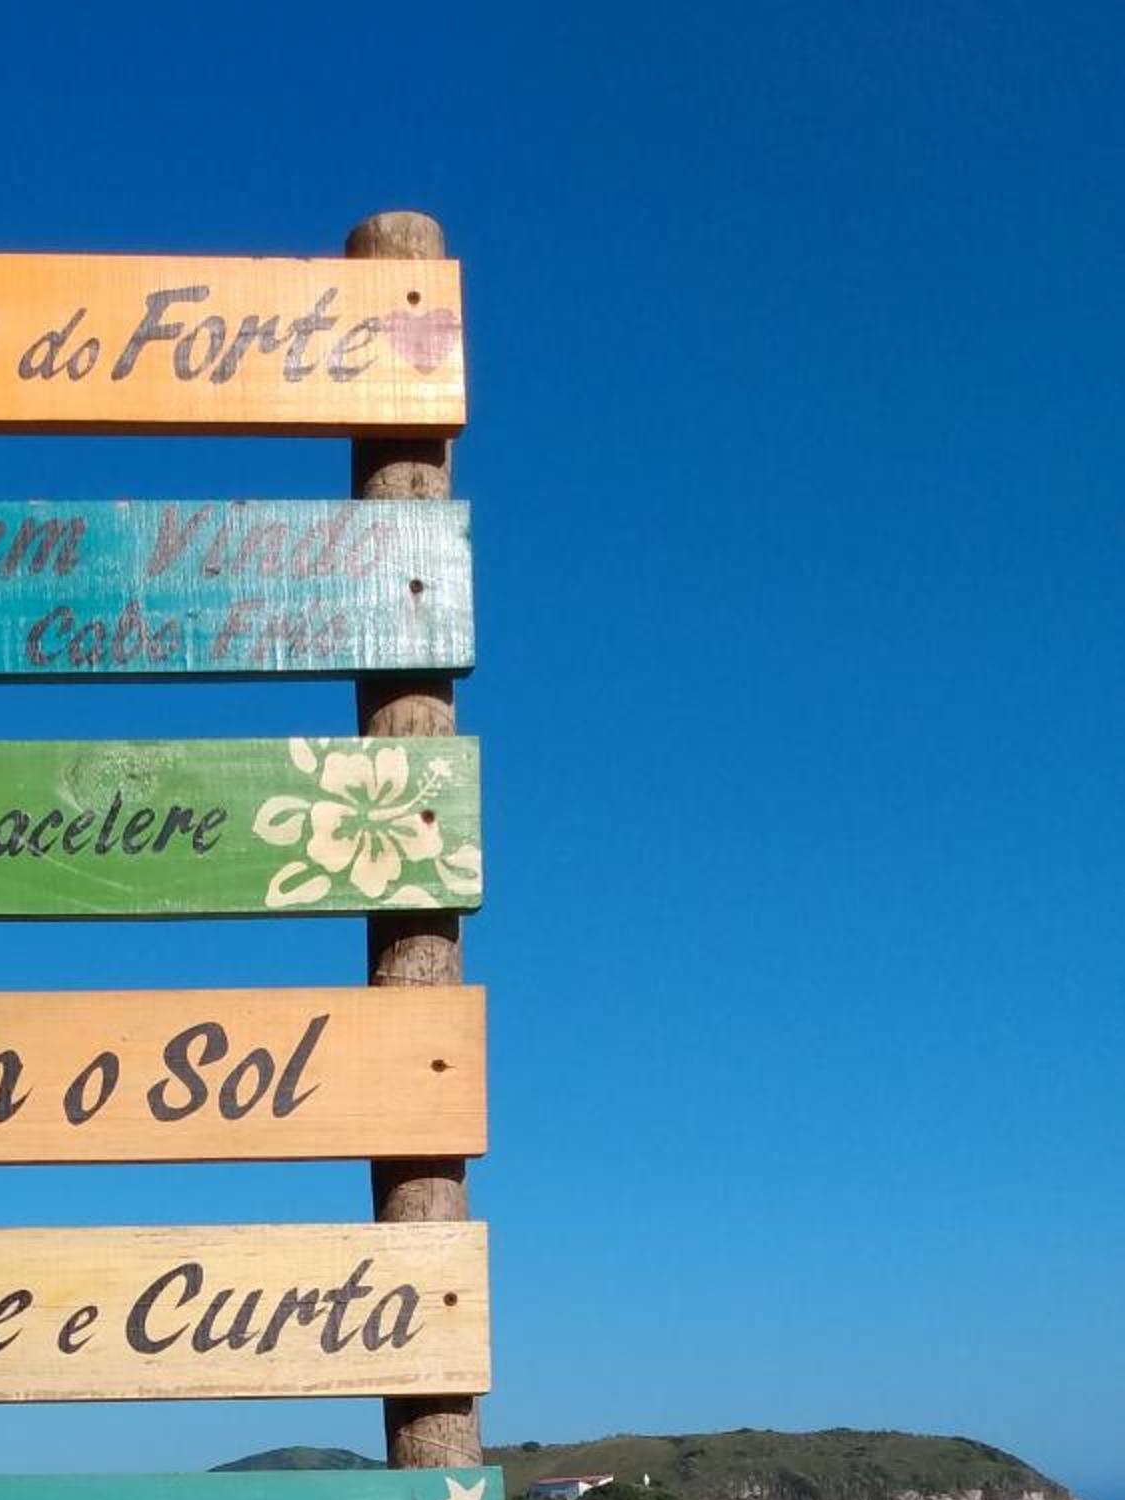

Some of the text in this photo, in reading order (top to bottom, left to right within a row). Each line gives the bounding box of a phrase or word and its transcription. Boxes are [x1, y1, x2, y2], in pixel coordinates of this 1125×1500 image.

[18, 308, 100, 383] do
[111, 285, 385, 383] Forte
[145, 498, 391, 581] Vindo
[25, 600, 185, 667] Cabo
[63, 1052, 121, 1126] o
[147, 1013, 331, 1122] Sol
[57, 1304, 97, 1355] e
[124, 1258, 425, 1356] Curta
